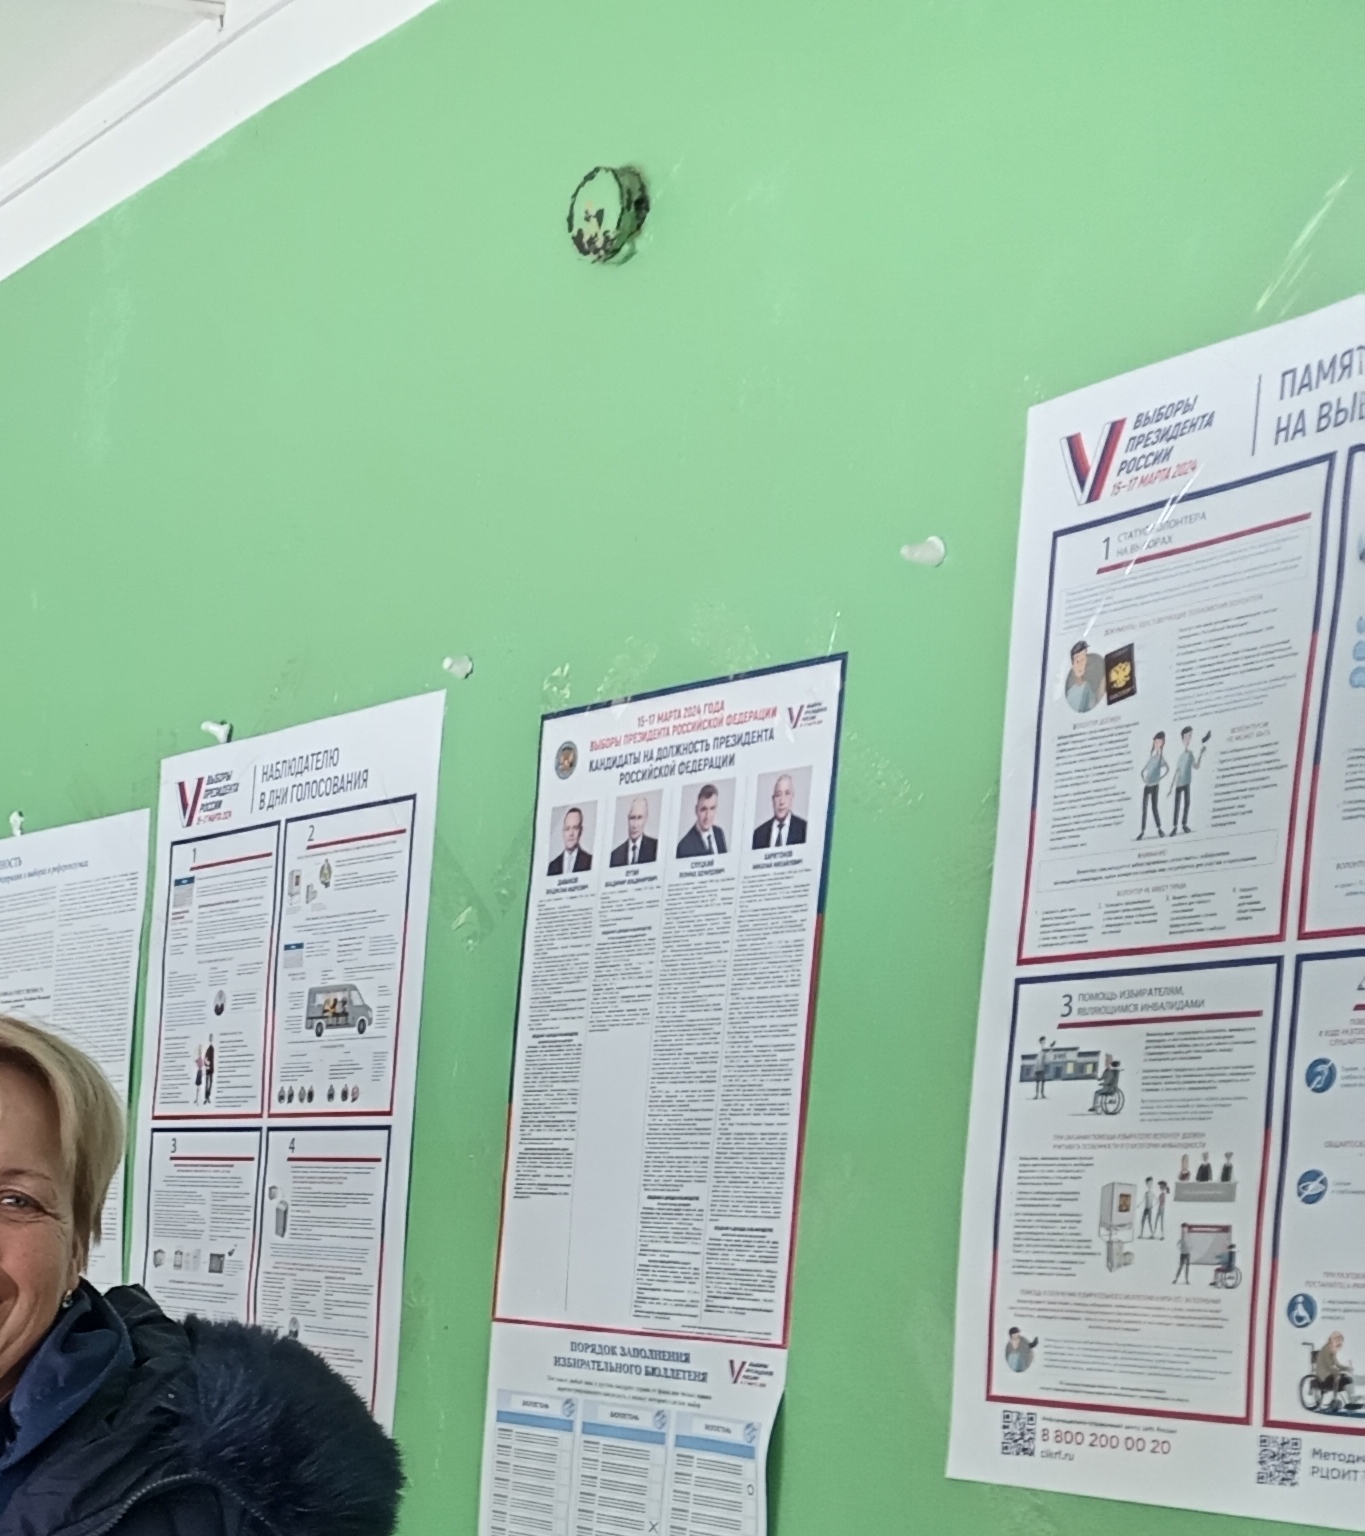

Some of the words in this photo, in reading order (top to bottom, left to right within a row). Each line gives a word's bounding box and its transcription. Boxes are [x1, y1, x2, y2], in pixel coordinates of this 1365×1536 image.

[1133, 395, 1199, 430] ВЫБОРЫ
[1125, 411, 1216, 453] ПРЕЗИДЕНТА
[1274, 409, 1306, 446] НА
[1117, 445, 1174, 477] РОССИИ
[1138, 467, 1170, 488] МАРТА
[1171, 458, 1198, 479] 2024
[1151, 511, 1207, 532] ЛОНТЕРА
[1102, 536, 1111, 560] 1
[1129, 534, 1174, 555] ВОРАХ
[656, 707, 683, 723] МАРТА
[683, 703, 702, 719] 2024
[703, 699, 725, 715] ГОДА
[589, 736, 622, 752] ВЫБОРЫ
[623, 726, 671, 746] ПРЕЗИДЕНТА
[671, 717, 725, 736] РОССИЙСКОЙ
[725, 706, 778, 727] ФЕДЕРАЦИИ
[588, 752, 642, 773] КАНДИДАТЫ
[642, 748, 655, 763] НА
[655, 737, 711, 762] ДОЛЖНОСТЬ
[712, 727, 775, 750] ПРЕЗИДЕНТА
[206, 770, 233, 786] ВЫБОРЫ
[262, 747, 340, 783] НАБЛЮДАТЕЛЮ
[619, 763, 676, 785] РОССИЙСКОЙ
[677, 753, 736, 774] ФЕДЕРАЦИИ
[259, 791, 265, 810] В
[266, 787, 288, 811] ДНИ
[290, 768, 369, 804] ГОЛОСОВАНИЯ
[199, 800, 223, 812] РОССИИ
[307, 824, 316, 842] 2
[1060, 994, 1073, 1017] 3
[170, 1137, 177, 1154] 3
[288, 1137, 296, 1154] 4
[570, 1341, 619, 1356] ПОРЯДОК
[619, 1346, 691, 1364] ЗАПОЛНЕНИЯ
[553, 1356, 643, 1376] ИЗБИРАТЕЛЬНОГО
[644, 1366, 709, 1383] БЮЛЛЕТЕНЯ
[1040, 1428, 1050, 1442] 8
[1054, 1430, 1085, 1445] 800
[1089, 1433, 1120, 1449] 200
[1124, 1436, 1146, 1452] 00
[1150, 1439, 1172, 1455] 20
